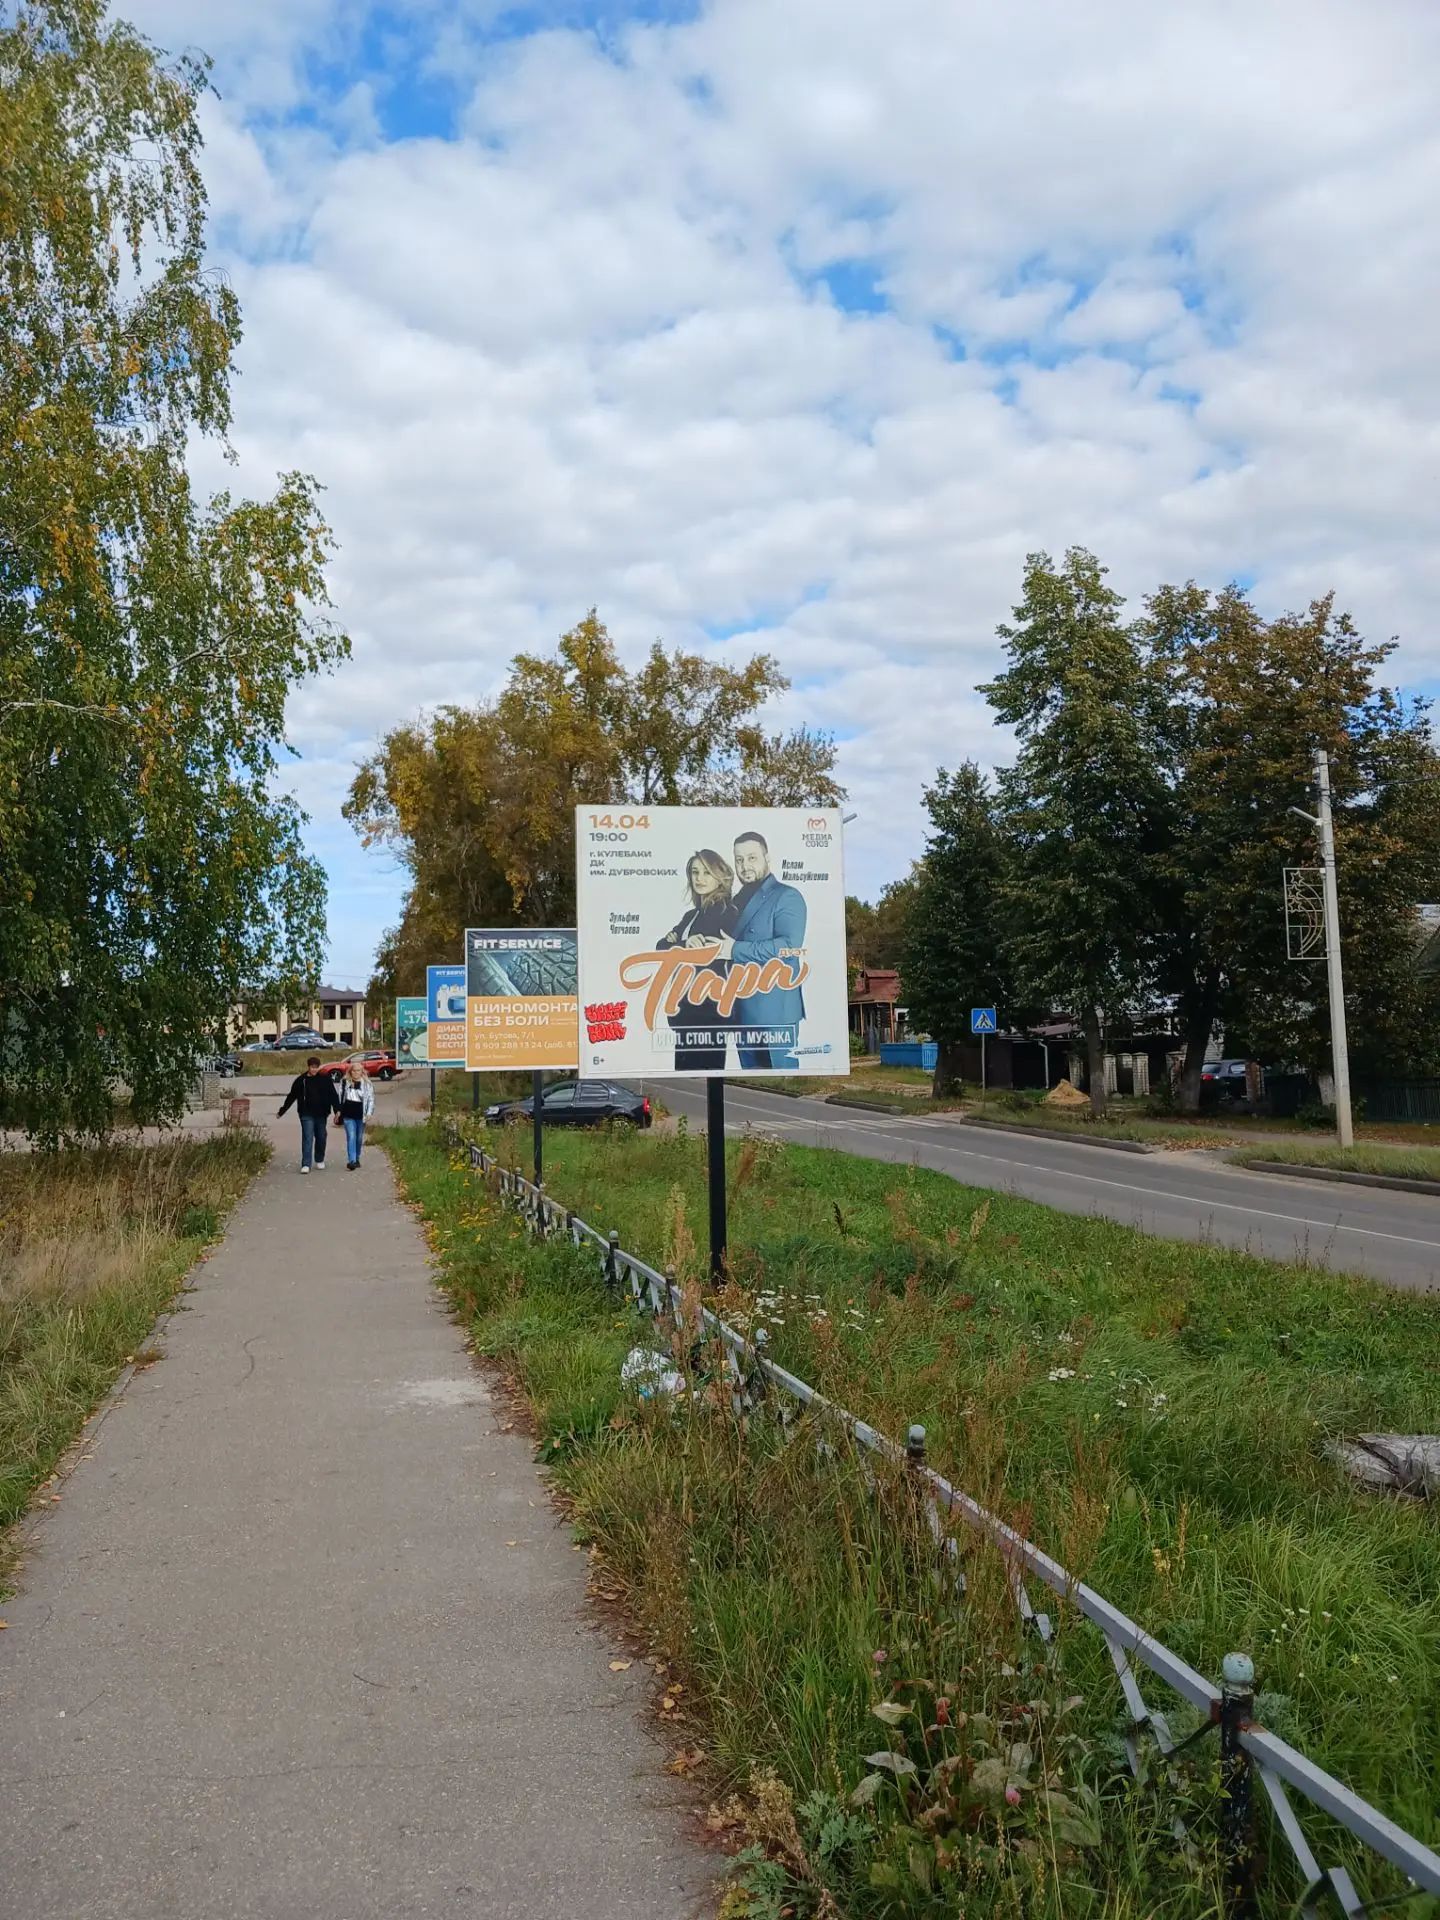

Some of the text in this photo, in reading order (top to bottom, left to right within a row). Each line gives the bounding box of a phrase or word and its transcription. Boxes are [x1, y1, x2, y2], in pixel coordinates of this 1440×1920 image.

[589, 815, 650, 829] 14.04
[589, 832, 628, 842] 19:00
[782, 859, 804, 870] Ислам
[608, 869, 678, 877] ДУБРОВСКИХ
[618, 944, 809, 1033] Пара
[474, 1016, 501, 1026] БЕЗ
[505, 1015, 549, 1026] БОЛИ
[686, 1031, 715, 1047] СТОП,
[746, 1029, 791, 1044] МУЗЫКА
[593, 1056, 605, 1065] 6+
